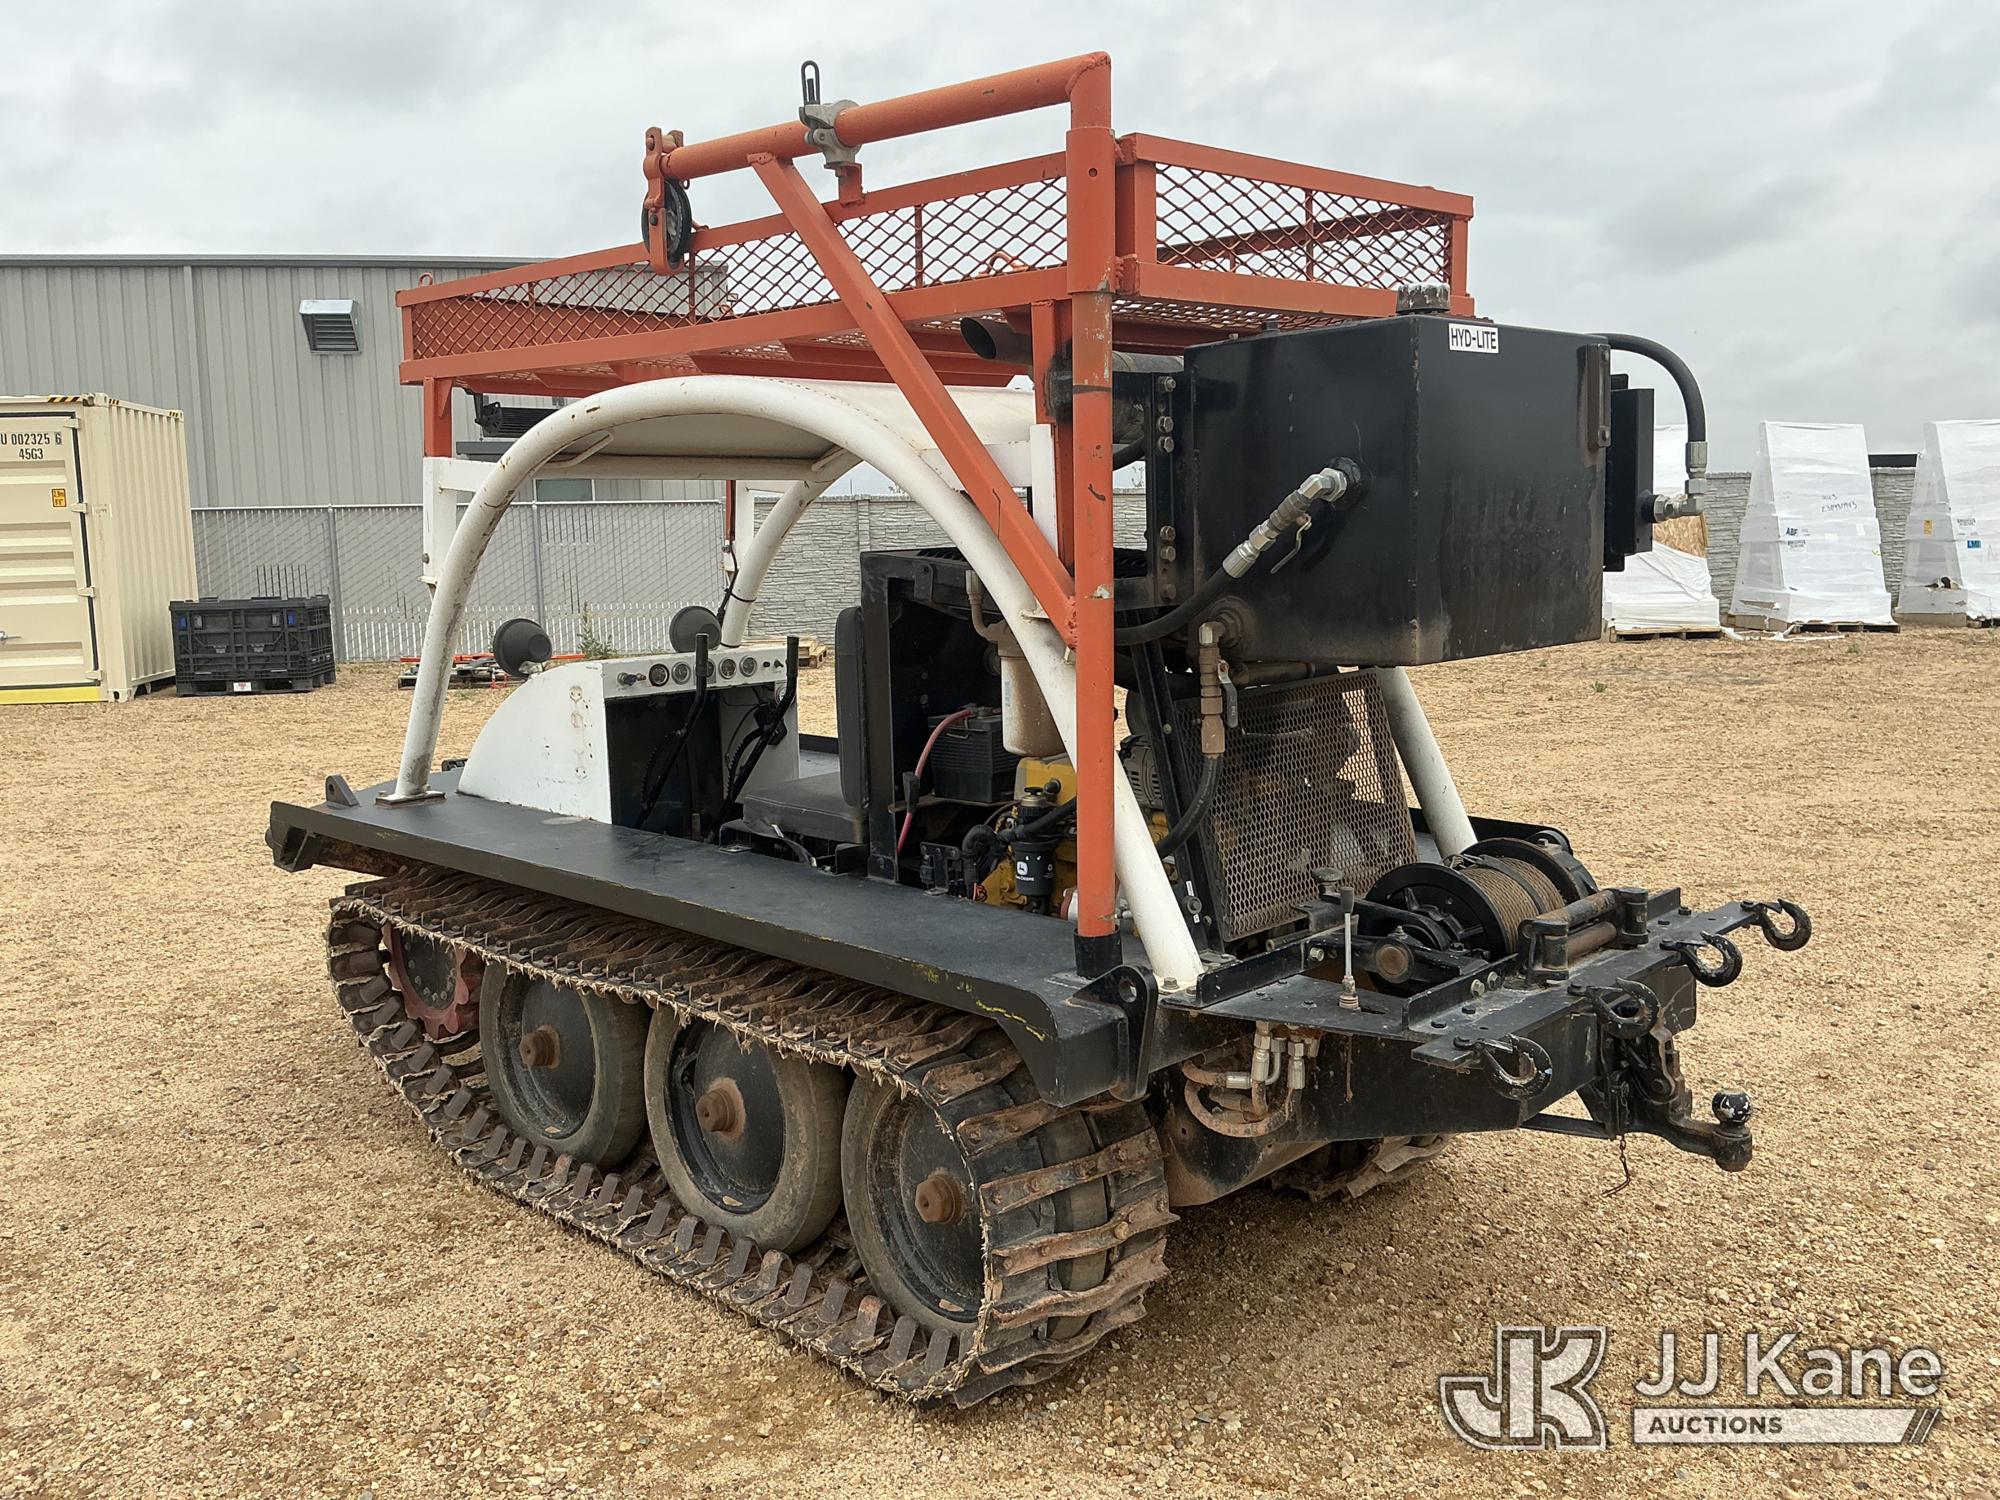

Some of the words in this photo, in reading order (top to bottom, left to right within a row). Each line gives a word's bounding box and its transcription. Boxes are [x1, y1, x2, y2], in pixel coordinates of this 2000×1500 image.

[1451, 328, 1497, 349] HYD-LITE
[11, 433, 50, 445] 002325
[55, 432, 62, 445] 6
[19, 448, 43, 460] 45G3
